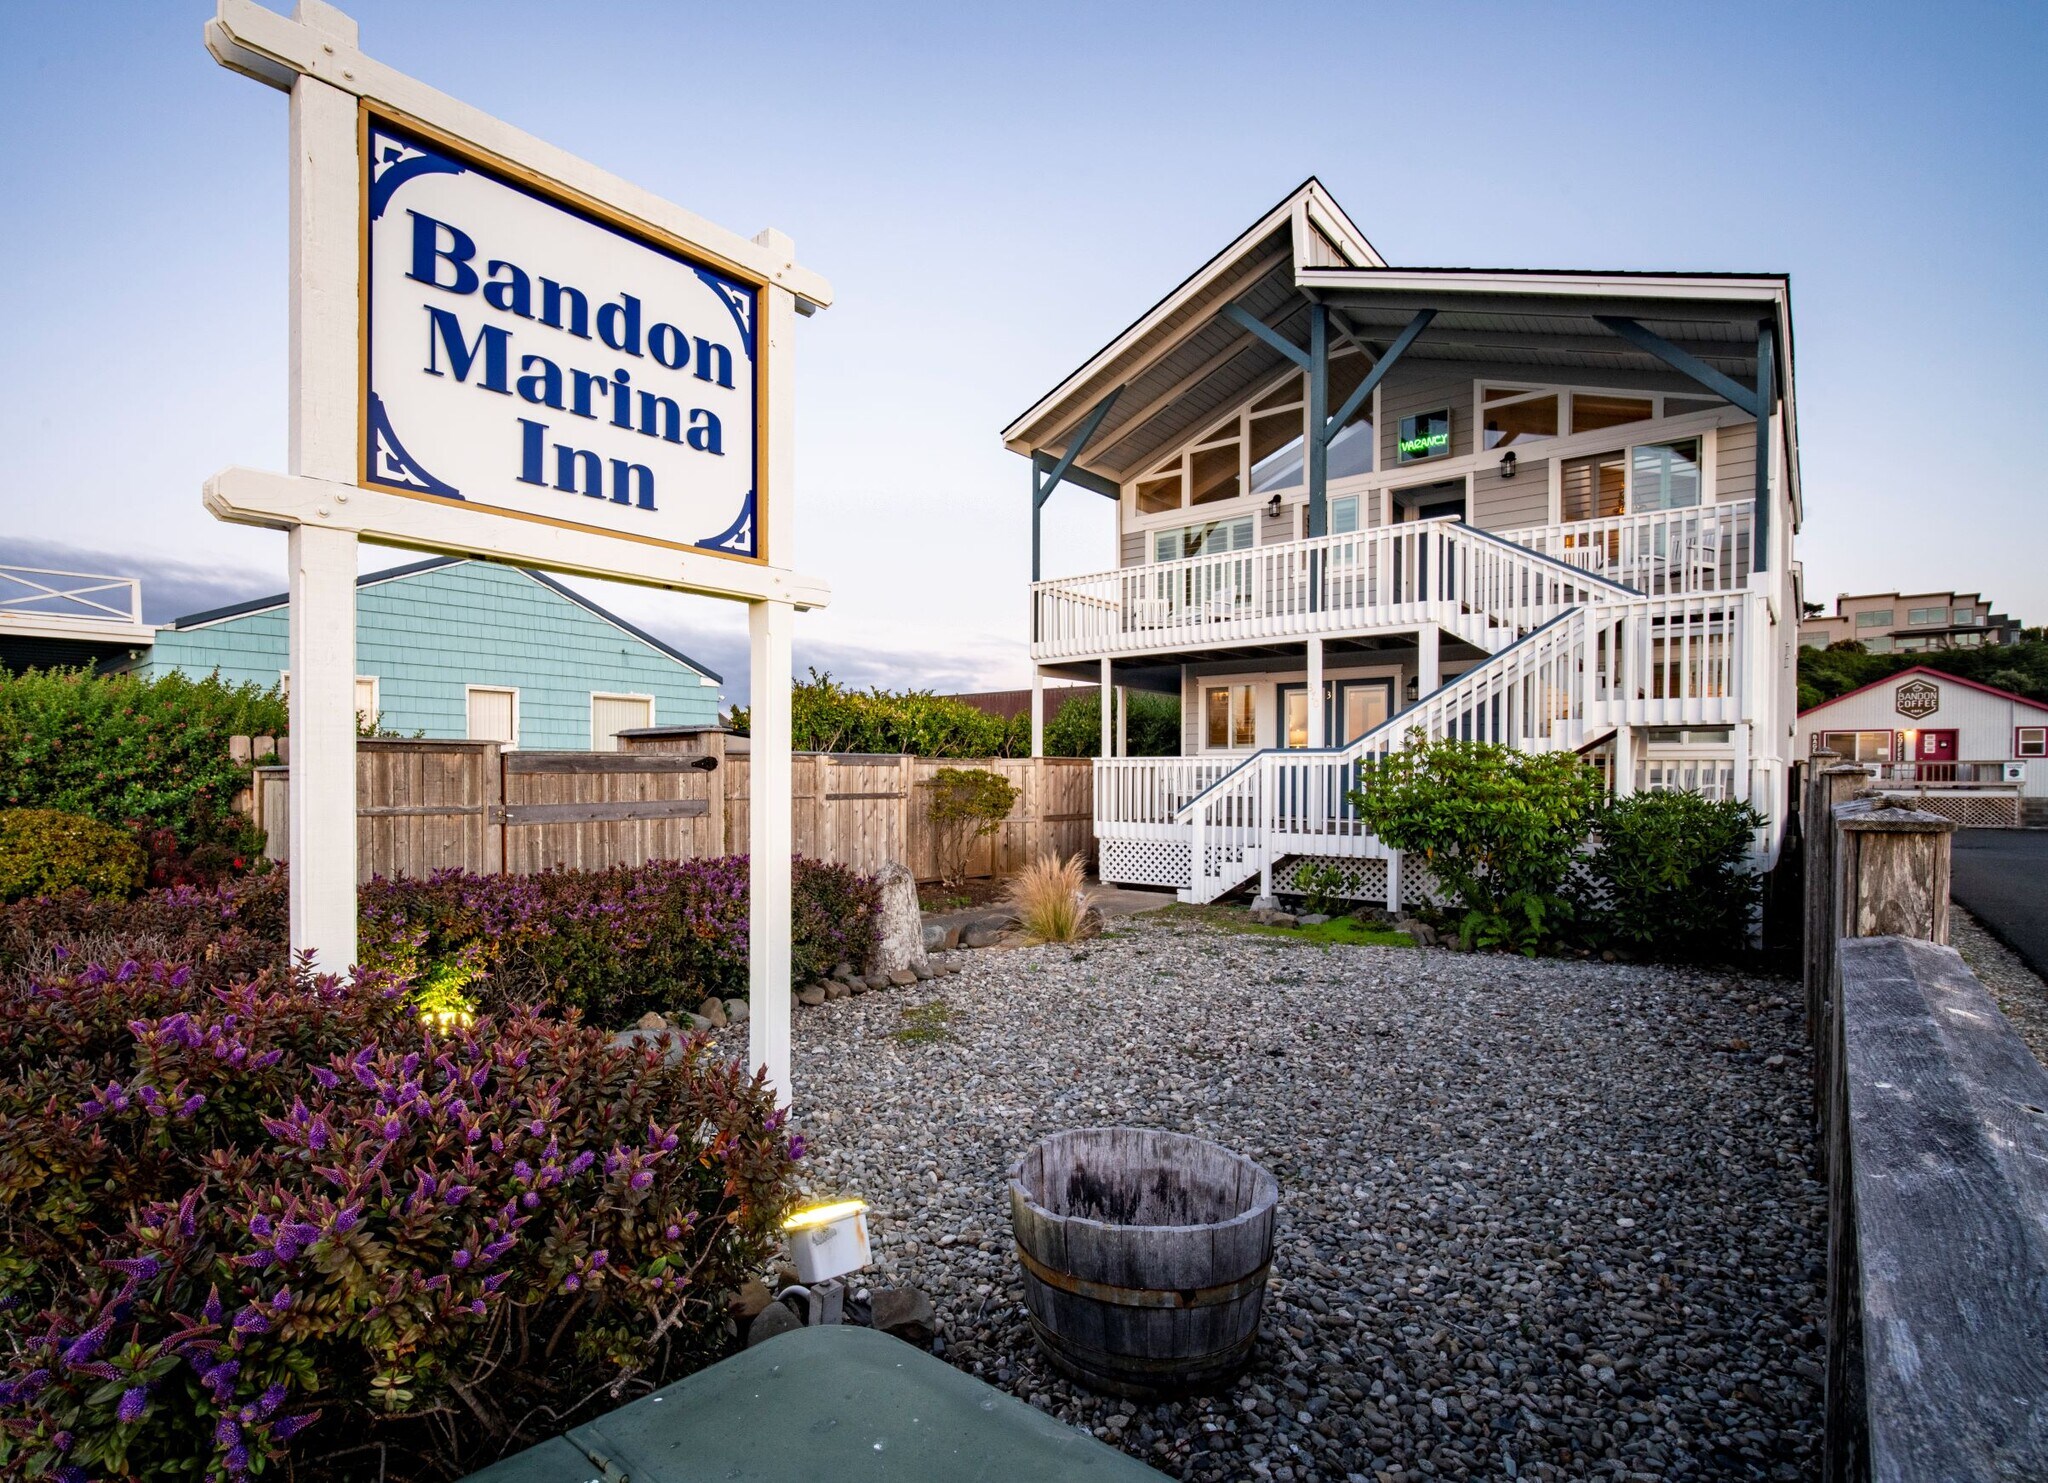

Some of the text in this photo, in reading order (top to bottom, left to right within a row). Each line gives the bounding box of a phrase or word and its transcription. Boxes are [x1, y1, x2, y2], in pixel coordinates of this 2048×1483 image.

[404, 208, 736, 390] Bandon
[422, 303, 726, 456] Marina
[516, 417, 659, 511] Inn
[1401, 433, 1448, 452] VACANCY
[1898, 692, 1937, 700] BANDON
[1898, 700, 1937, 708] COFFEE
